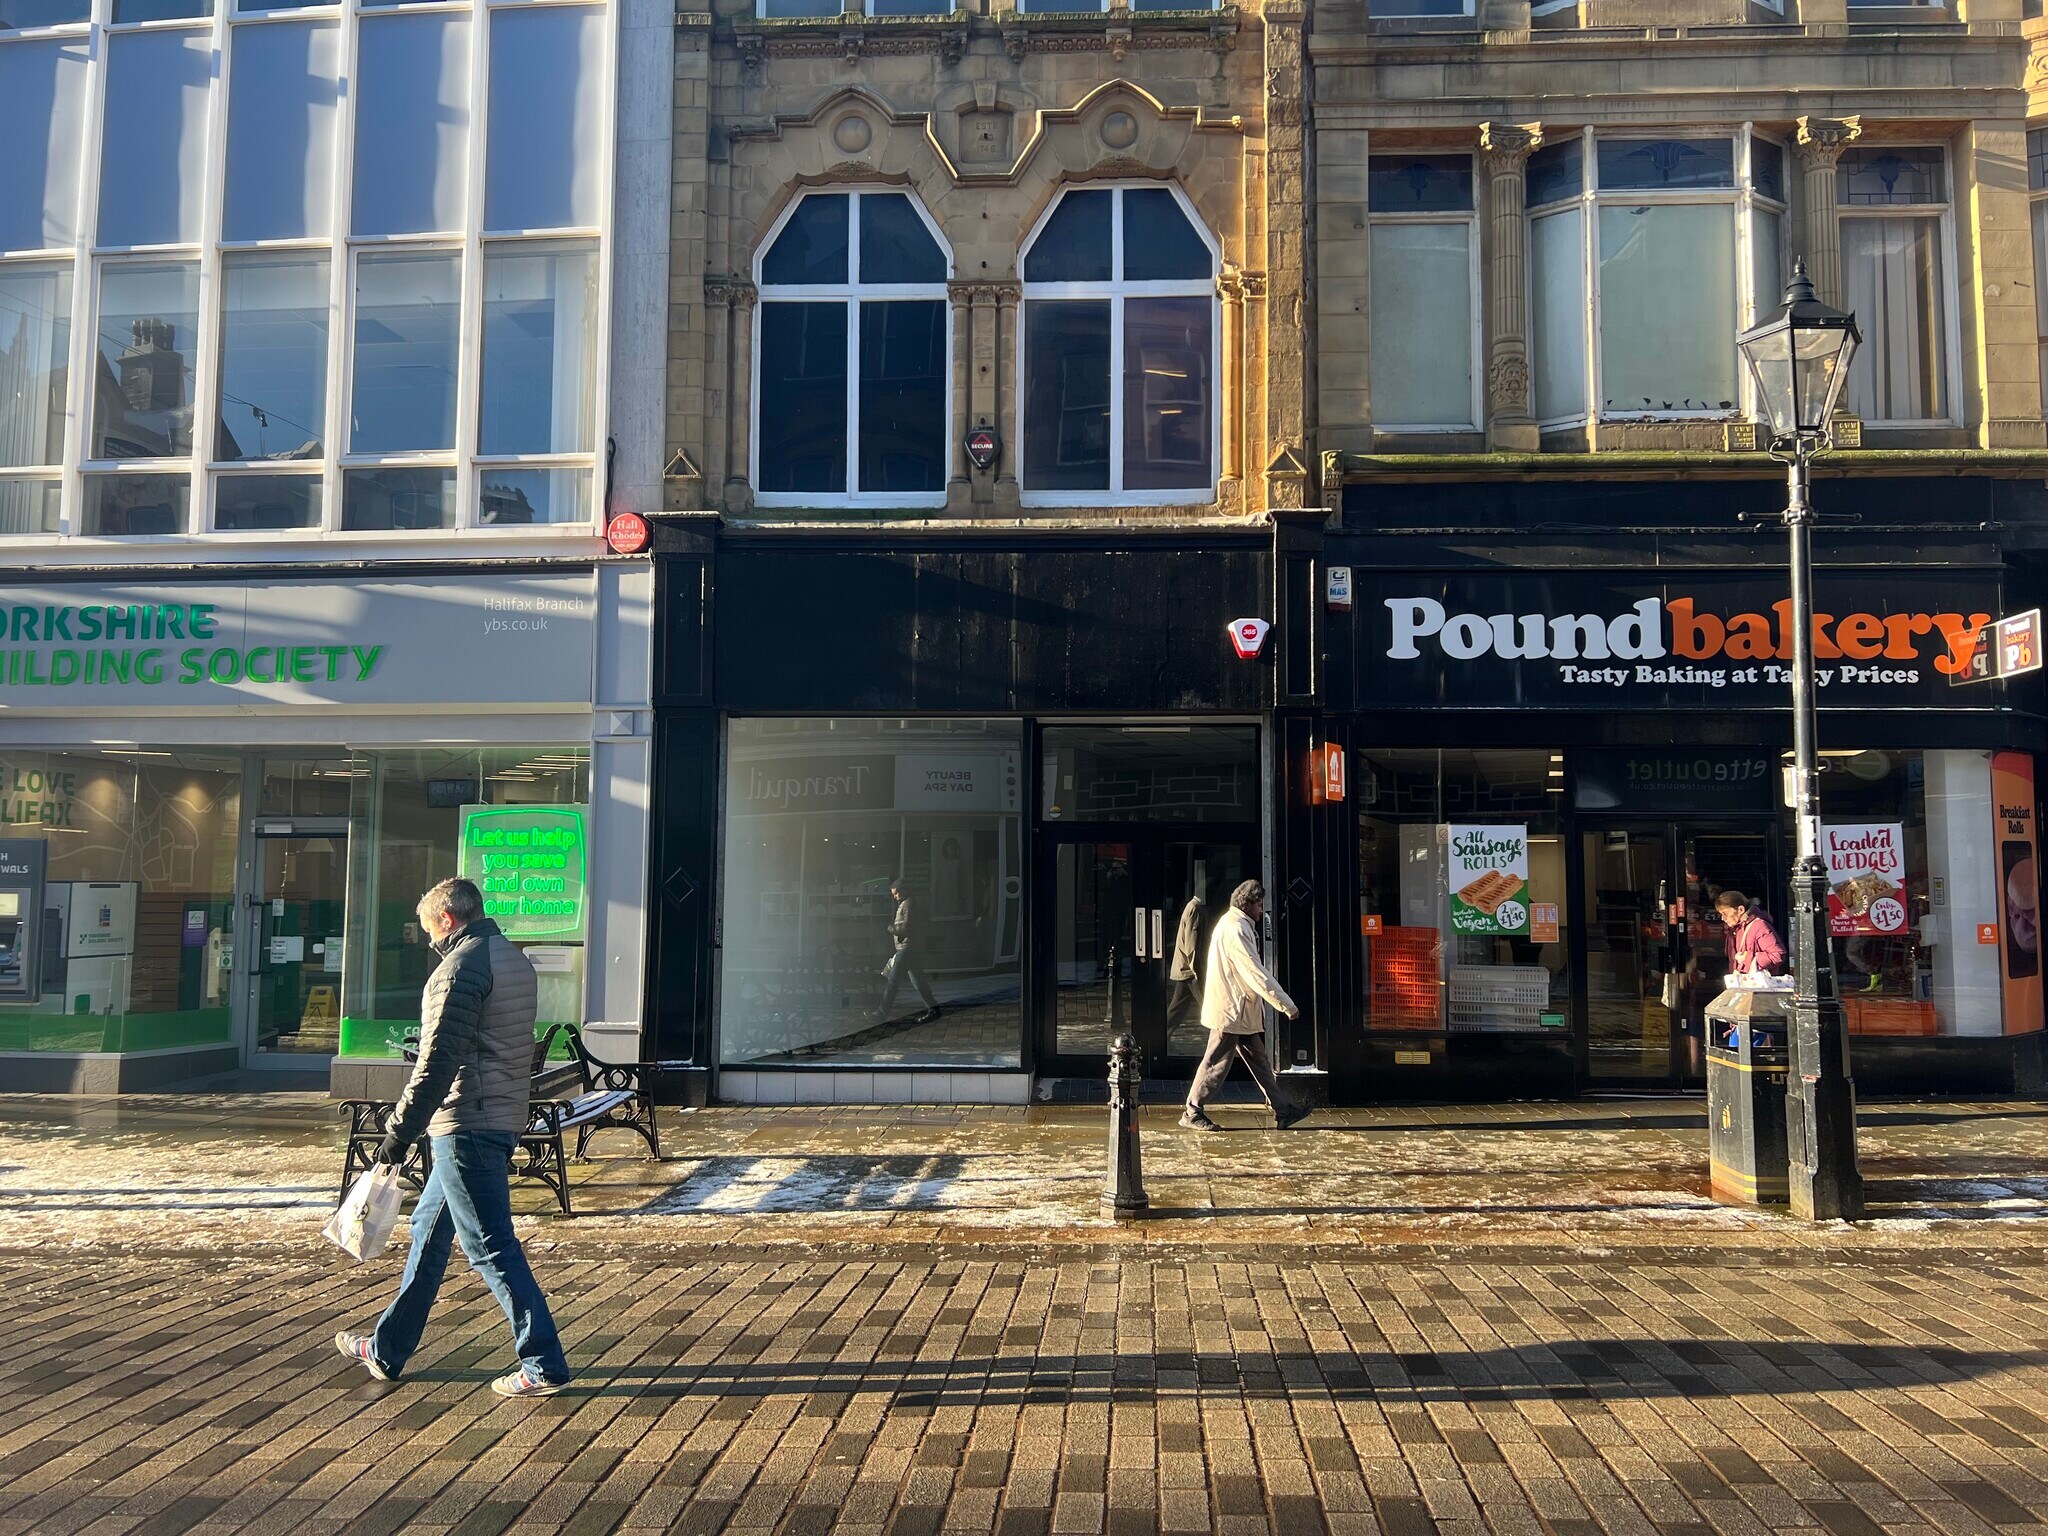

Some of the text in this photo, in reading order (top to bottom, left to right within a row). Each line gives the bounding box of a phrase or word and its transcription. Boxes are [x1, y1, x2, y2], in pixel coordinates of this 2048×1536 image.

[617, 520, 638, 529] Hall
[1329, 587, 1347, 596] MAS
[484, 597, 584, 611] Halifax Branch
[0, 604, 215, 641] RKSHIRE
[484, 617, 548, 634] ybs.co.uk
[2005, 617, 2031, 634] Pound
[2006, 631, 2031, 645] bakery
[0, 645, 382, 685] ILDING SOCIETY
[2006, 643, 2032, 670] Pb
[1559, 665, 1919, 686] Tasty Baking at Tay Prices
[13, 768, 75, 796] LOVE
[2000, 805, 2031, 819] Breakfast
[2008, 820, 2024, 834] Rolls
[473, 828, 576, 850] Let us help
[1465, 831, 1486, 843] All
[1830, 828, 1893, 851] Loaded
[1453, 837, 1524, 862] Sausage
[482, 854, 566, 874] you save
[1463, 856, 1507, 870] ROLLS
[1832, 849, 1898, 873] WEDGES
[483, 872, 564, 892] and own
[484, 896, 575, 915] our home
[1502, 904, 1508, 914] 2
[1452, 916, 1493, 932] Vegan
[1500, 911, 1524, 927] £1.40
[1874, 909, 1902, 927] £1.50
